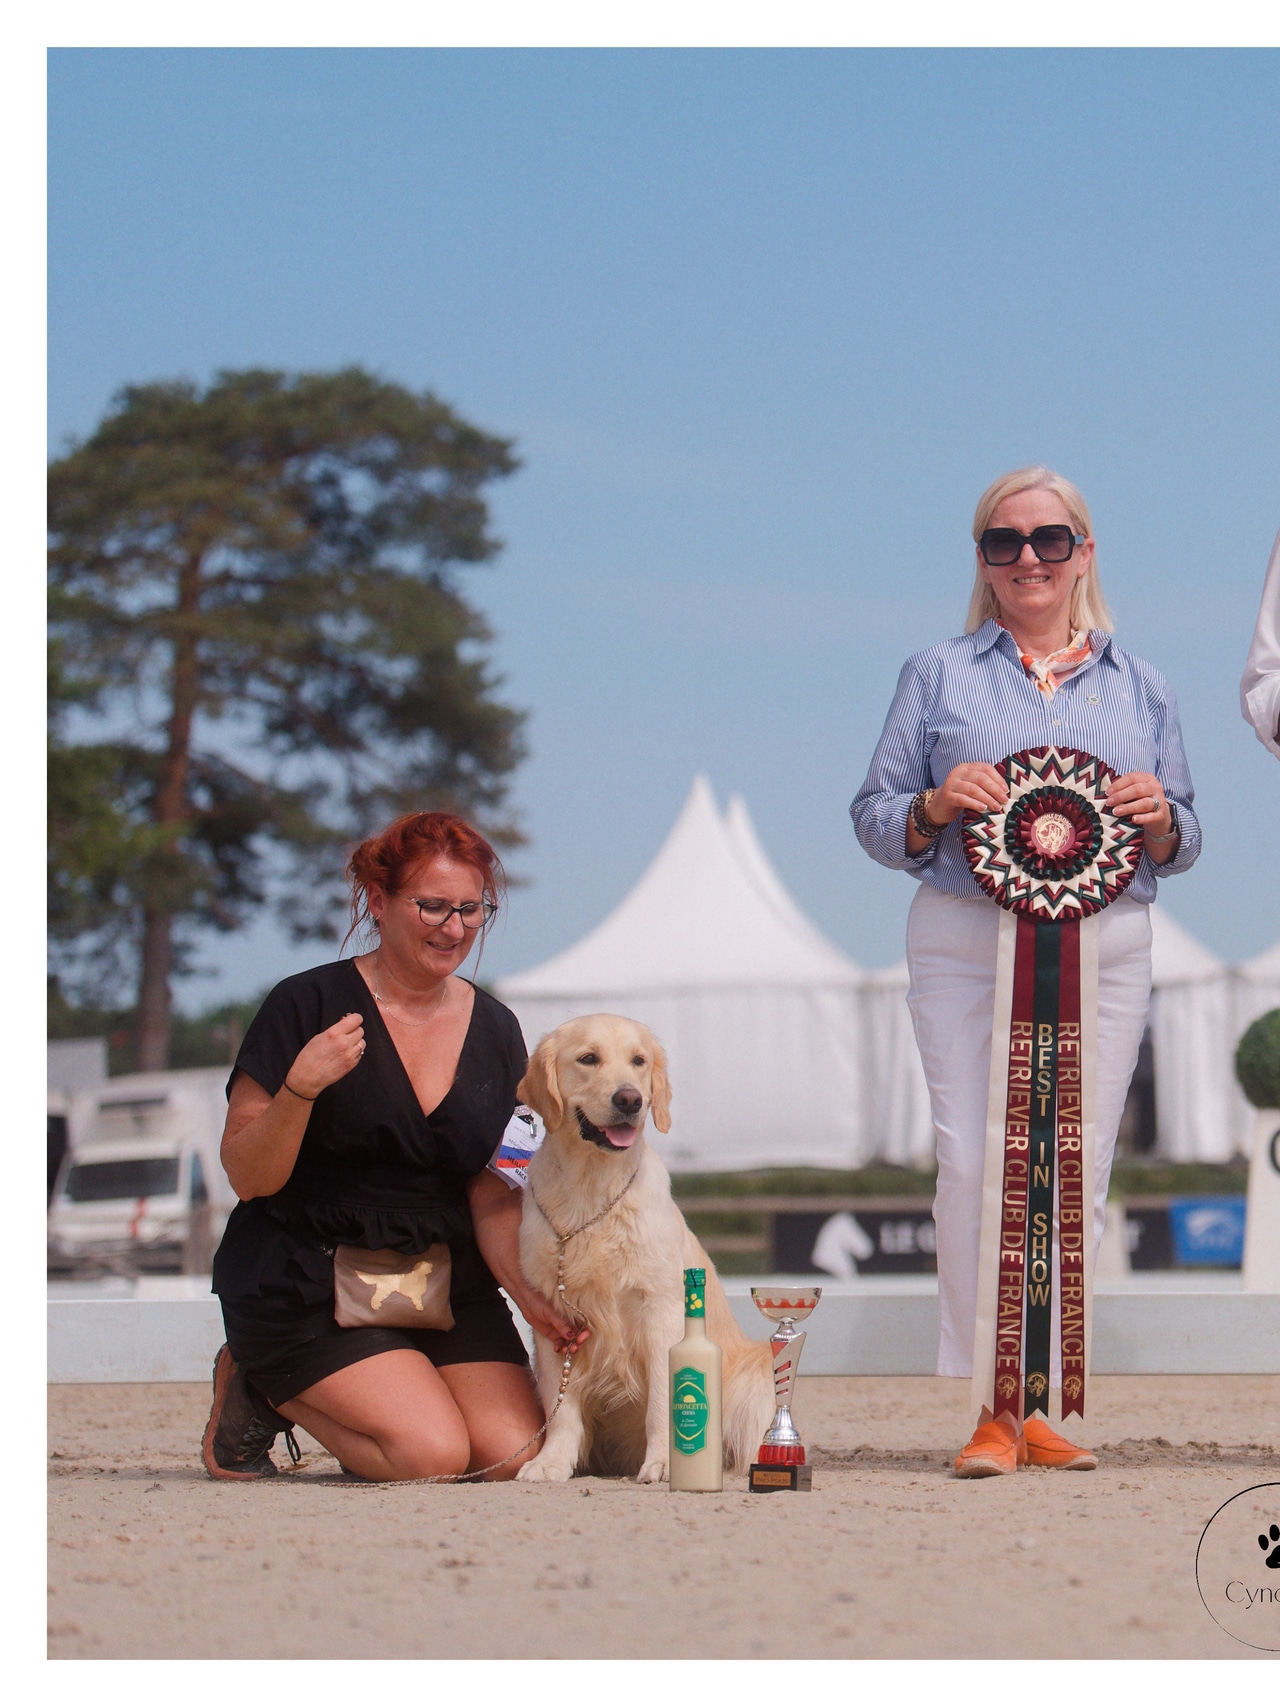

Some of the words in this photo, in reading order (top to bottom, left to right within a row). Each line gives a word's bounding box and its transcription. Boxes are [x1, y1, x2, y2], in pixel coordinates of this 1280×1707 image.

[1006, 1021, 1034, 1151] RETRIEVER
[1035, 1023, 1053, 1117] BEST
[1057, 1022, 1082, 1152] RETRIEVER
[1003, 1158, 1028, 1223] CLUB
[1033, 1141, 1049, 1188] IN
[1059, 1159, 1082, 1224] CLUB
[1000, 1231, 1025, 1265] DE
[1028, 1212, 1050, 1307] SHOW
[1060, 1232, 1083, 1265] DE
[996, 1271, 1023, 1369] FRANCE
[1061, 1272, 1084, 1370] FRANCE
